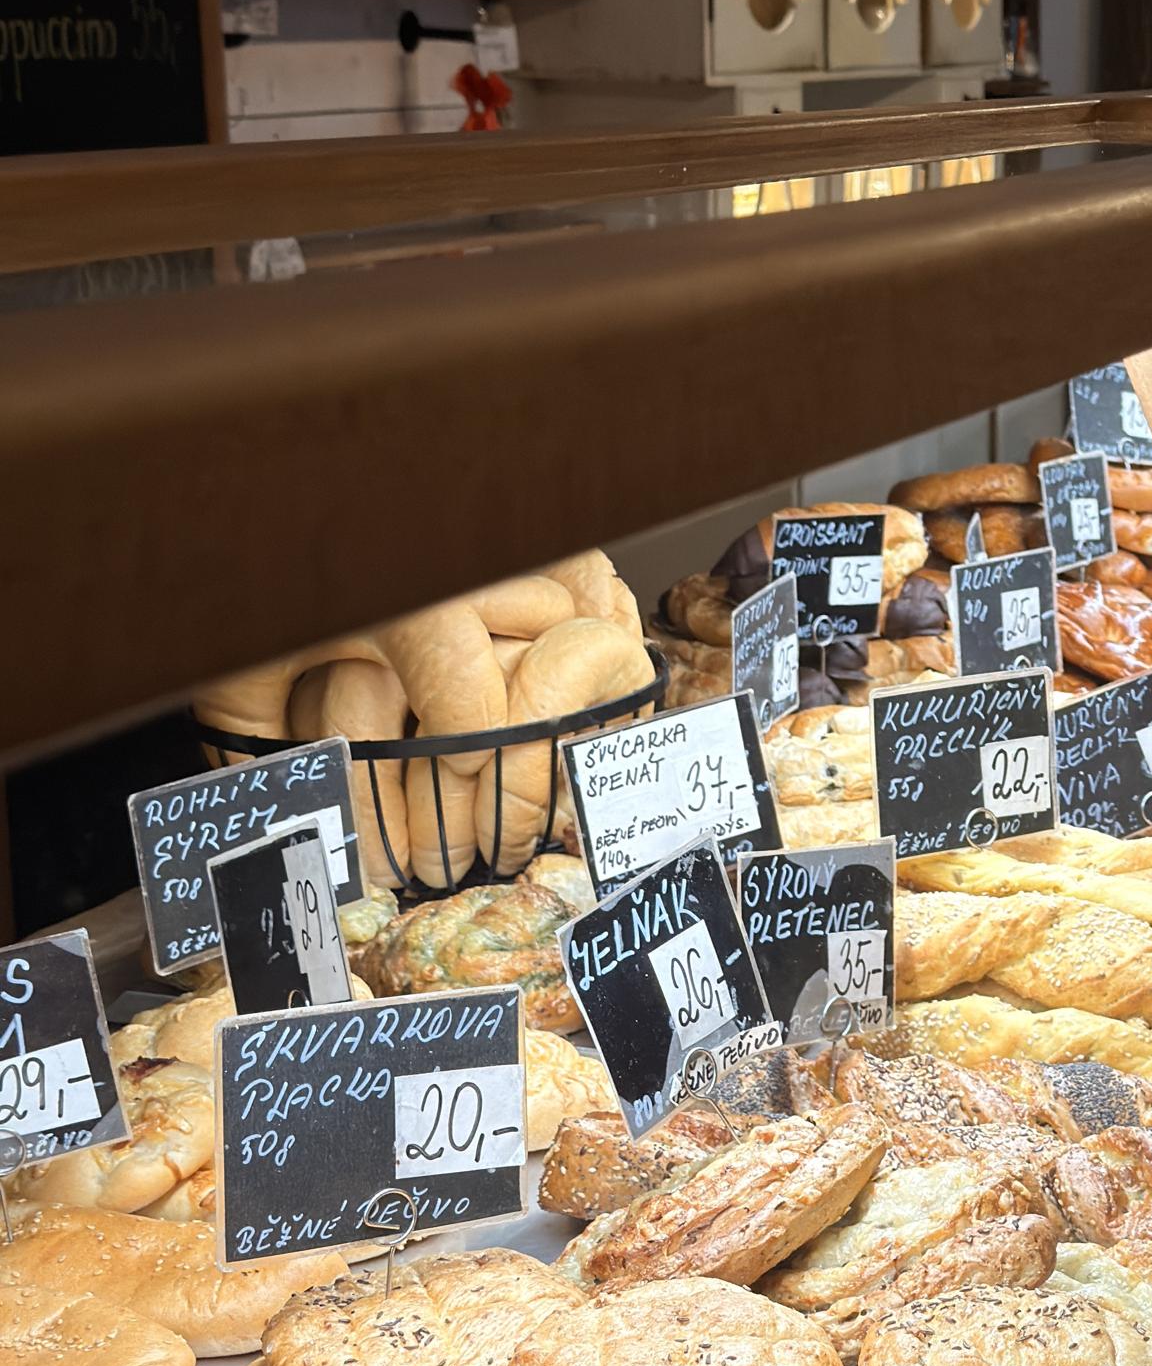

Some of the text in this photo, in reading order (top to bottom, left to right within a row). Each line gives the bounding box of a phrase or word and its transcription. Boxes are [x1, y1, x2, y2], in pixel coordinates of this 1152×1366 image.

[776, 521, 875, 548] CROISSANT
[837, 561, 880, 598] 35,-
[1005, 597, 1040, 642] 25,-
[583, 723, 688, 769] ŠVÝCARKA
[144, 754, 329, 828] ROHLÍK SE
[991, 746, 1048, 803] 22,-
[153, 803, 278, 879] SÝREM
[743, 855, 837, 907] SÝROVÝ
[167, 923, 221, 960] BĚŽN
[749, 900, 880, 948] PLETENEC
[670, 947, 727, 1028] 26,-
[833, 936, 882, 996] 35,-
[233, 996, 519, 1083] ŠKVARKOVÁ
[719, 1027, 780, 1070] PEČIVO
[0, 1056, 91, 1126] 29,-
[240, 1067, 402, 1124] PLACKA
[405, 1081, 520, 1163] 20,-
[235, 1199, 353, 1255] BĚŽNÉ
